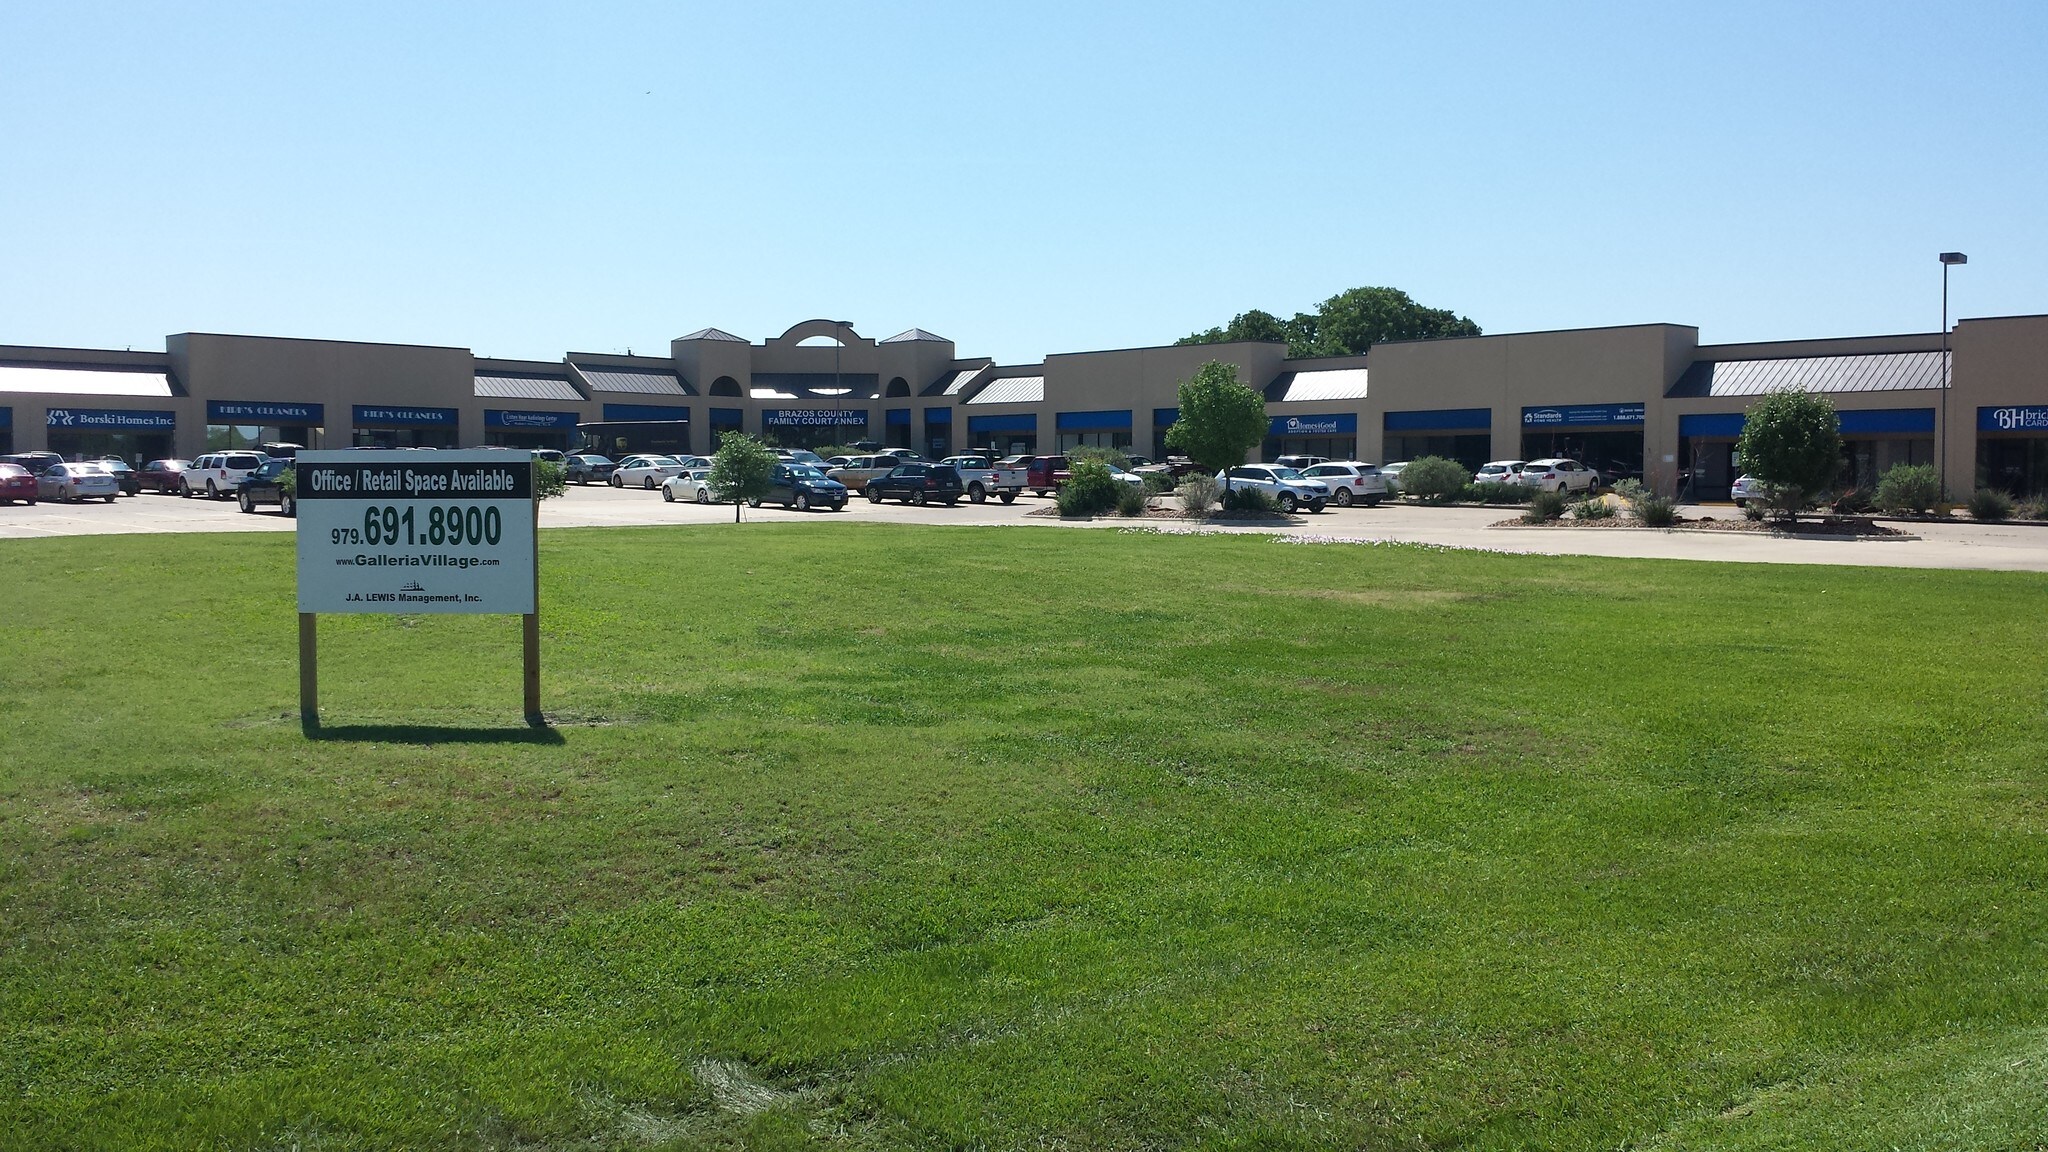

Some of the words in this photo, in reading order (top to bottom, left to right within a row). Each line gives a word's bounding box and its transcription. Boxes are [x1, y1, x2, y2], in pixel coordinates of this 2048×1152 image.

[256, 407, 307, 415] CLEANERS
[397, 411, 443, 419] CLEANERS
[2025, 408, 2048, 420] bric
[80, 414, 115, 424] Borski
[117, 415, 154, 425] Homes
[155, 416, 175, 425] Inc.
[768, 417, 799, 425] FAMILY
[801, 417, 832, 425] COURT
[834, 417, 865, 425] ANNEX
[311, 469, 351, 491] Office
[354, 470, 359, 491] /
[362, 469, 401, 491] Retail
[405, 469, 447, 496] Space
[451, 469, 514, 491] Available
[335, 554, 500, 569] www.GalleriaVillage.com
[345, 594, 363, 602] J.A.
[366, 593, 396, 602] LEWIS
[398, 593, 462, 604] Management,
[464, 593, 482, 602] Inc.
